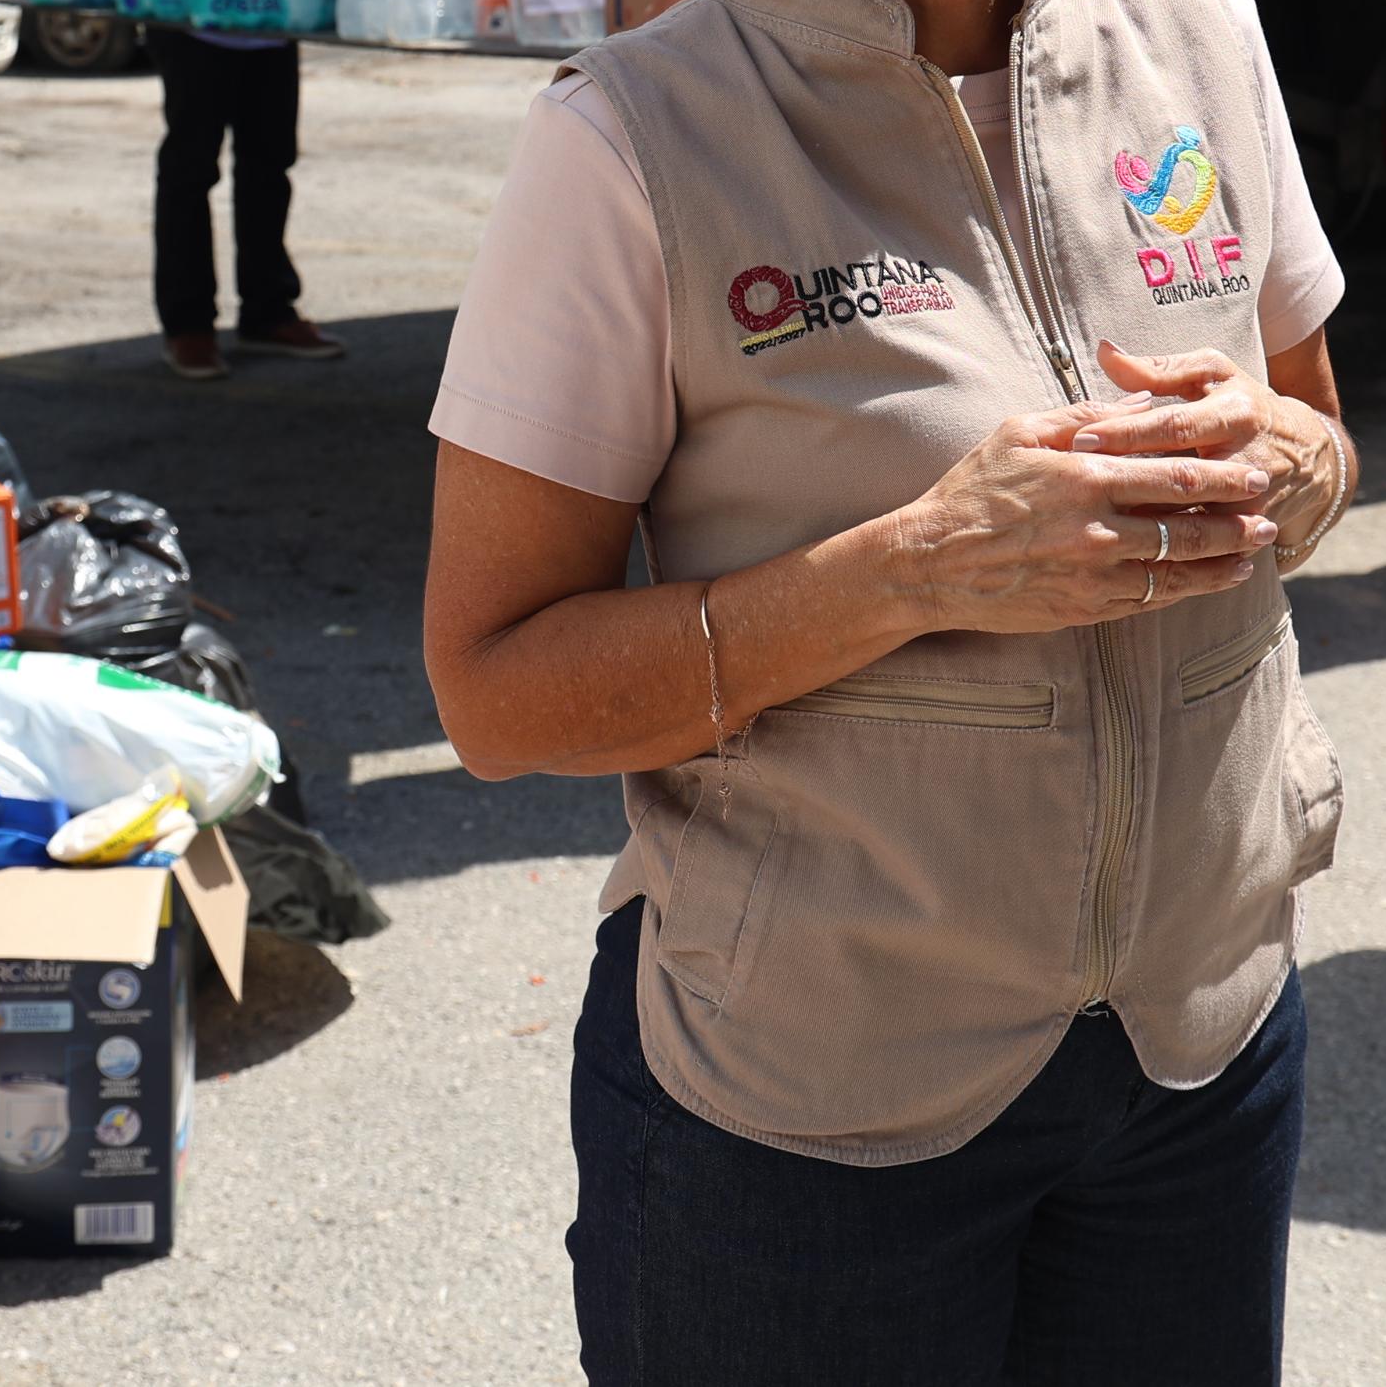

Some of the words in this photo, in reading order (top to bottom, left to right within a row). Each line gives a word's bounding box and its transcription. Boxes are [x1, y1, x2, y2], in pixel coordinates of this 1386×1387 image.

[1137, 235, 1242, 288] DIF
[728, 260, 945, 332] QUINTANA
[1153, 279, 1220, 306] QUINTANA
[1221, 274, 1250, 296] ROO
[802, 291, 883, 332] ROO
[742, 328, 806, 356] 2022/2027
